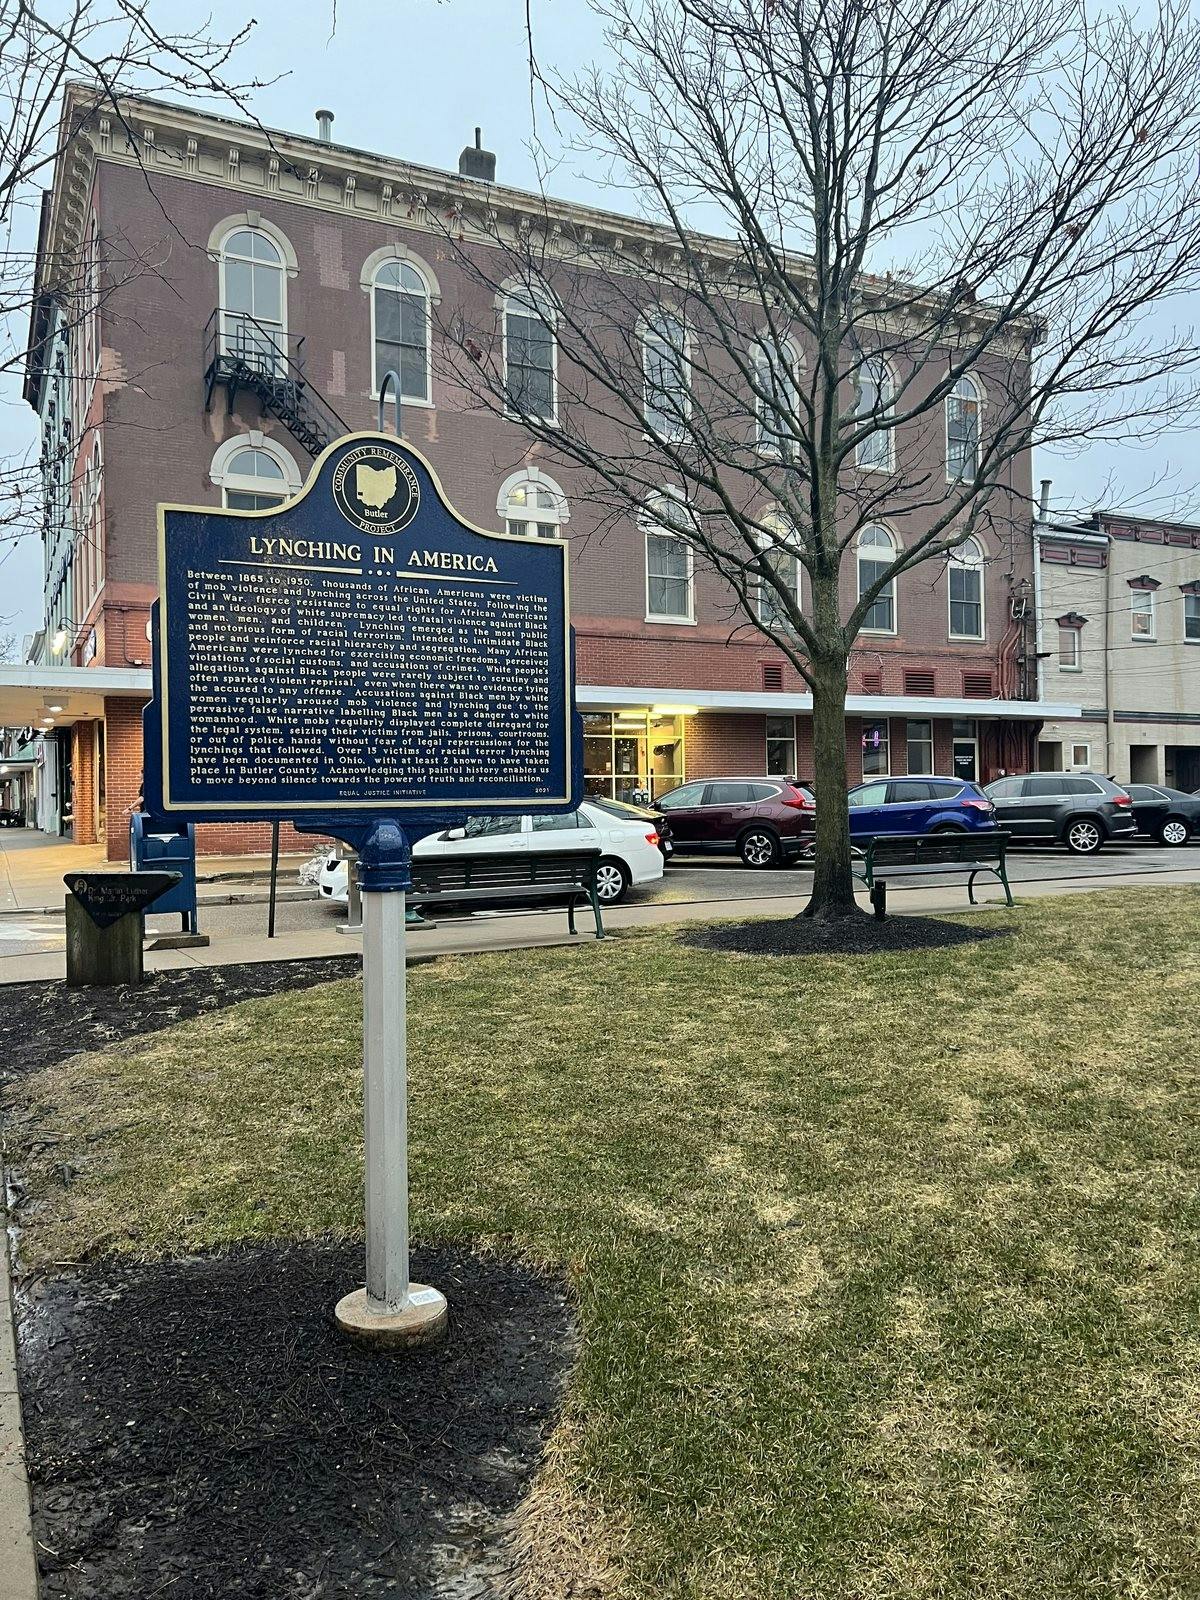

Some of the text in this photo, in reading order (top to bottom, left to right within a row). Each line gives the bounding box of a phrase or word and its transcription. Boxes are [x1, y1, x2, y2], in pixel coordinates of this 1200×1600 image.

[334, 448, 419, 498] COMMUNITY REMEMBRANCE
[364, 509, 388, 518] Butler
[360, 521, 395, 533] PROJECT
[250, 536, 499, 573] LYNCHING IN AMERICA
[231, 584, 278, 594] violence
[306, 589, 351, 601] lynching
[356, 593, 388, 601] across
[393, 595, 408, 603] the
[413, 596, 444, 605] United
[448, 598, 480, 607] States.
[486, 600, 529, 612] Following
[229, 604, 277, 616] ideology
[296, 608, 326, 617] white
[330, 611, 385, 622] supremacy
[388, 613, 404, 622] led
[421, 615, 444, 624] fatal
[447, 617, 486, 627] violence
[490, 620, 521, 629] against
[524, 621, 548, 630] Black
[188, 633, 225, 643] people
[230, 635, 249, 643] and
[254, 636, 305, 645] reinforce
[309, 639, 340, 647] racial
[344, 640, 395, 651] hierarchy
[420, 645, 480, 654] segregation.
[486, 646, 511, 656] Many
[514, 648, 548, 657] African
[189, 642, 247, 653] Americans
[283, 646, 326, 656] lynched
[330, 649, 346, 657] for
[350, 651, 405, 662] exercising
[409, 654, 453, 662] economic
[505, 658, 549, 666] perceived
[189, 663, 250, 674] allegations
[255, 666, 294, 676] against
[299, 667, 328, 676] Black
[333, 669, 366, 678] people
[400, 672, 432, 681] rarely
[437, 672, 473, 682] subject
[491, 675, 529, 685] scrutiny
[190, 683, 208, 692] the
[213, 685, 258, 693] accused
[262, 686, 274, 694] to
[279, 688, 298, 696] any
[303, 687, 345, 696] offense.
[354, 688, 415, 698] Accusations
[419, 691, 454, 700] against
[459, 692, 484, 700] Black
[509, 693, 521, 702] by
[235, 695, 288, 706] regularly
[297, 698, 339, 706] aroused
[347, 698, 367, 706] mob
[374, 699, 418, 708] violence
[449, 700, 490, 711] lynching
[189, 705, 244, 714] pervasive
[251, 705, 278, 714] false
[284, 707, 335, 715] narrative
[340, 707, 386, 718] labelling
[392, 708, 418, 717] Black
[473, 711, 505, 720] danger
[190, 715, 258, 724] womanhood.
[267, 716, 298, 724] White
[304, 717, 329, 725] mobs
[334, 717, 384, 727] regularly
[389, 718, 436, 728] displayed
[440, 720, 483, 729] complete
[486, 720, 531, 730] disregard
[232, 735, 244, 744] of
[250, 736, 284, 746] police
[291, 736, 321, 744] hands
[328, 736, 369, 745] without
[374, 737, 396, 745] fear
[402, 737, 412, 745] of
[417, 737, 442, 747] legal
[447, 738, 512, 748] repercussions
[190, 745, 243, 756] lynchings
[277, 746, 325, 754] followed.
[336, 746, 362, 754] Over
[367, 746, 377, 755] 15
[382, 747, 420, 755] victims
[511, 748, 550, 758] lynching
[190, 766, 220, 776] place
[225, 766, 236, 774] in
[240, 766, 274, 774] Butler
[278, 766, 319, 775] County.
[329, 766, 404, 776] Acknowledging
[428, 766, 462, 775] painful
[466, 766, 499, 775] history
[238, 776, 277, 785] beyond
[281, 775, 317, 784] silence
[384, 776, 413, 784] power
[120, 894, 137, 903] Park
